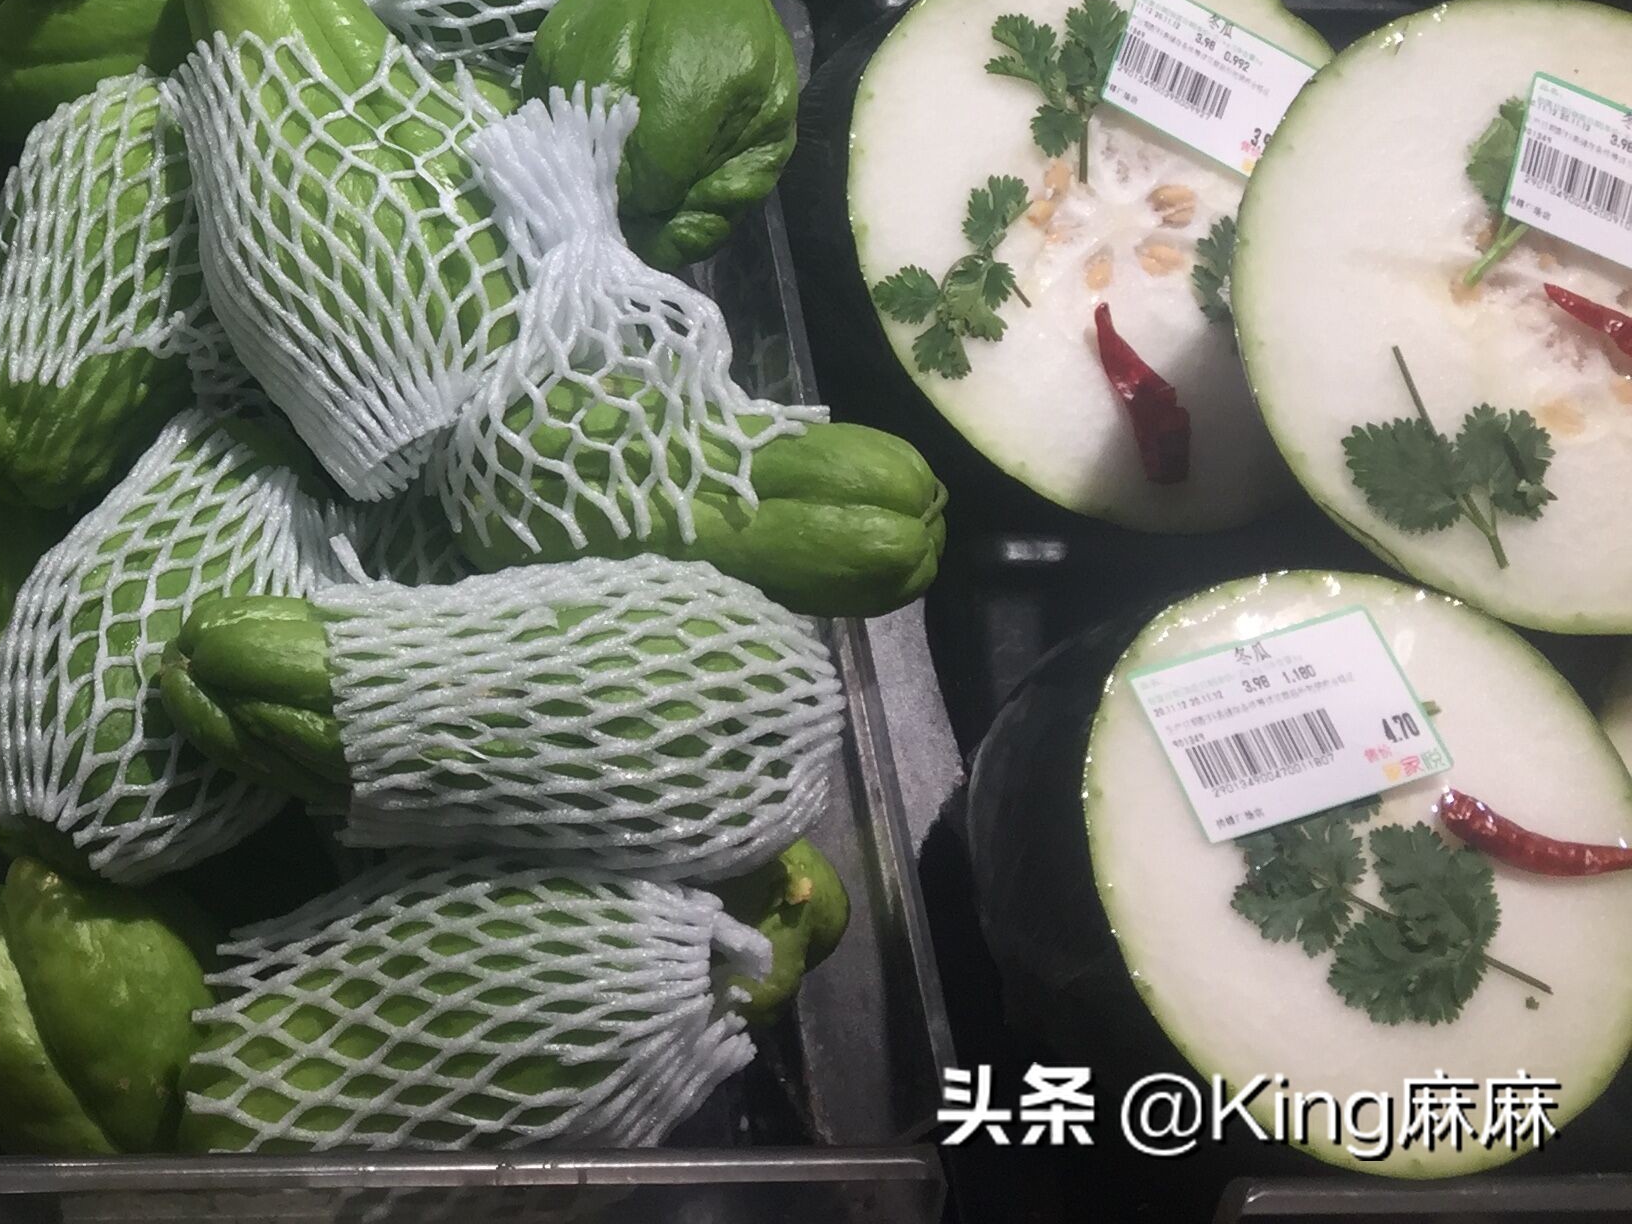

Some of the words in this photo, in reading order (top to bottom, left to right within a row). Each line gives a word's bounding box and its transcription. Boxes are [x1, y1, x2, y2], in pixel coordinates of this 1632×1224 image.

[1208, 13, 1234, 40] 冬瓜
[1195, 32, 1217, 52] 3.98
[1223, 50, 1250, 73] 0.992
[1233, 641, 1272, 666] 冬瓜
[1153, 700, 1188, 718] 20.11.12
[1188, 689, 1224, 707] 20.11.12
[1242, 674, 1271, 694] 3.98
[1282, 664, 1317, 685] 1.180
[1381, 712, 1421, 743] 4.70
[1212, 753, 1336, 797] 290134900470011807
